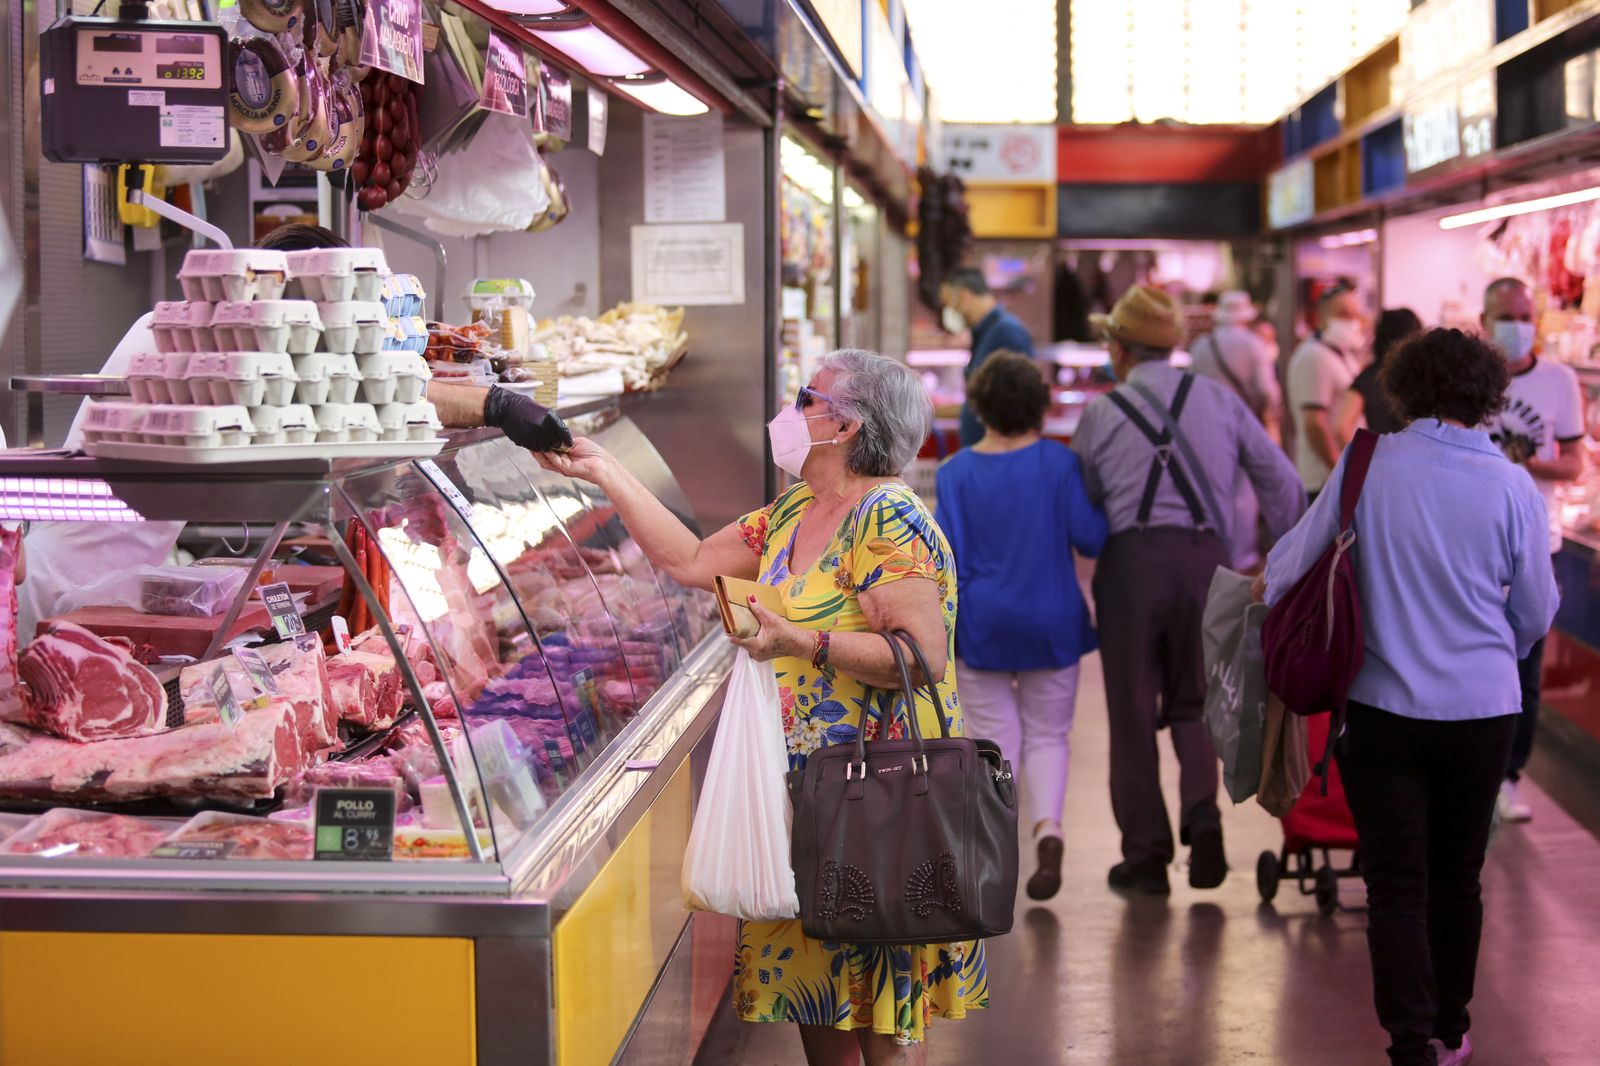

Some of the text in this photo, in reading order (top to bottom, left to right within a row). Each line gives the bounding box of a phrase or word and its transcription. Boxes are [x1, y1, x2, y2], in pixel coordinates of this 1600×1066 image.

[229, 93, 260, 120] MORCILLA
[329, 135, 348, 157] RONDA
[336, 800, 374, 811] POLLO
[333, 810, 377, 819] AL CURRY
